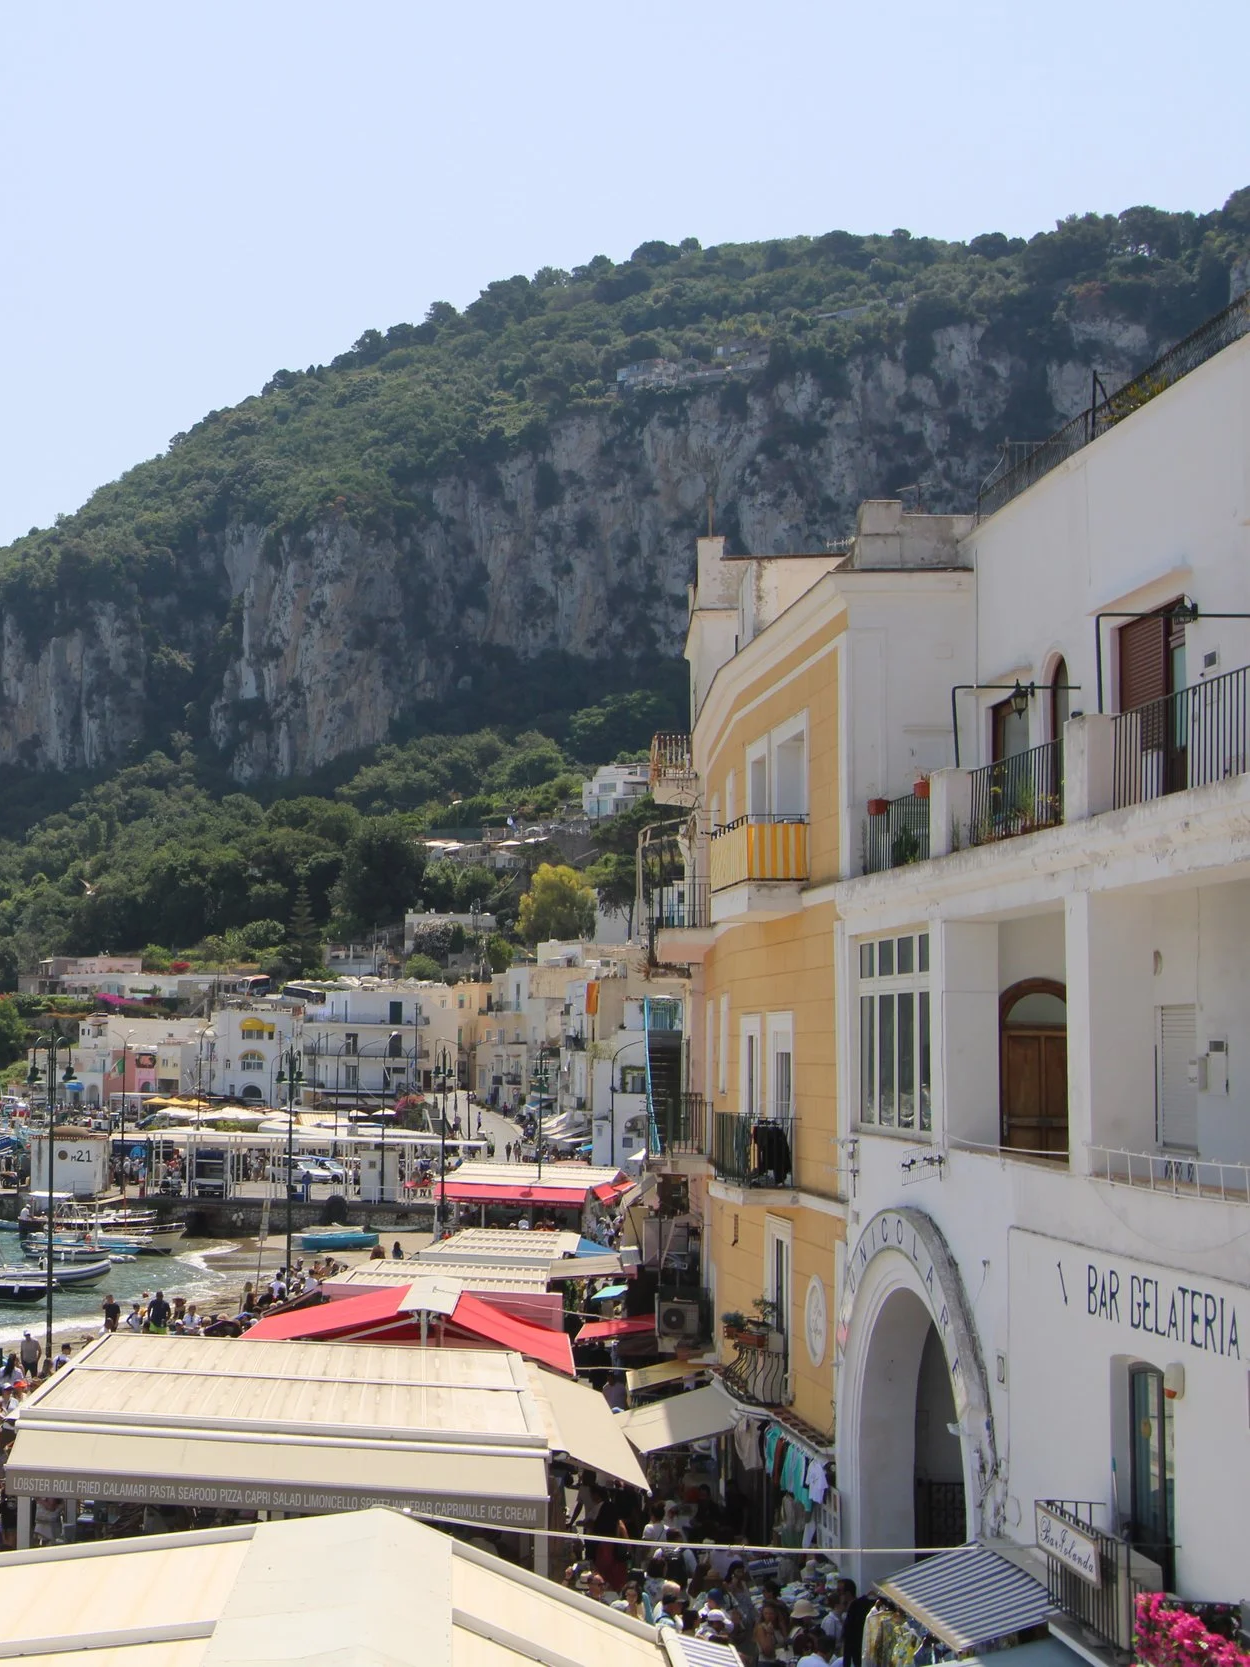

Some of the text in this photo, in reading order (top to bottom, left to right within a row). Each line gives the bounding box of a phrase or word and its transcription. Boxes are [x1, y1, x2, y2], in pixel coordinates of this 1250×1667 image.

[1087, 1264, 1240, 1360] BAR GELATERIA
[13, 1477, 50, 1492] LOBSTER
[53, 1479, 74, 1493] ROLL
[76, 1480, 100, 1495] FRIED
[103, 1481, 147, 1497] CALAMARI
[150, 1483, 176, 1500] PASTA
[178, 1485, 217, 1502] SEAFOOD
[220, 1487, 242, 1503] PIZZA
[245, 1488, 270, 1505] CAPRI
[272, 1492, 300, 1507] SALAD
[303, 1493, 358, 1510] LIMONCELLO
[434, 1503, 486, 1519] CAPRIMULE
[487, 1506, 502, 1520] ICE
[504, 1507, 537, 1522] CREAM
